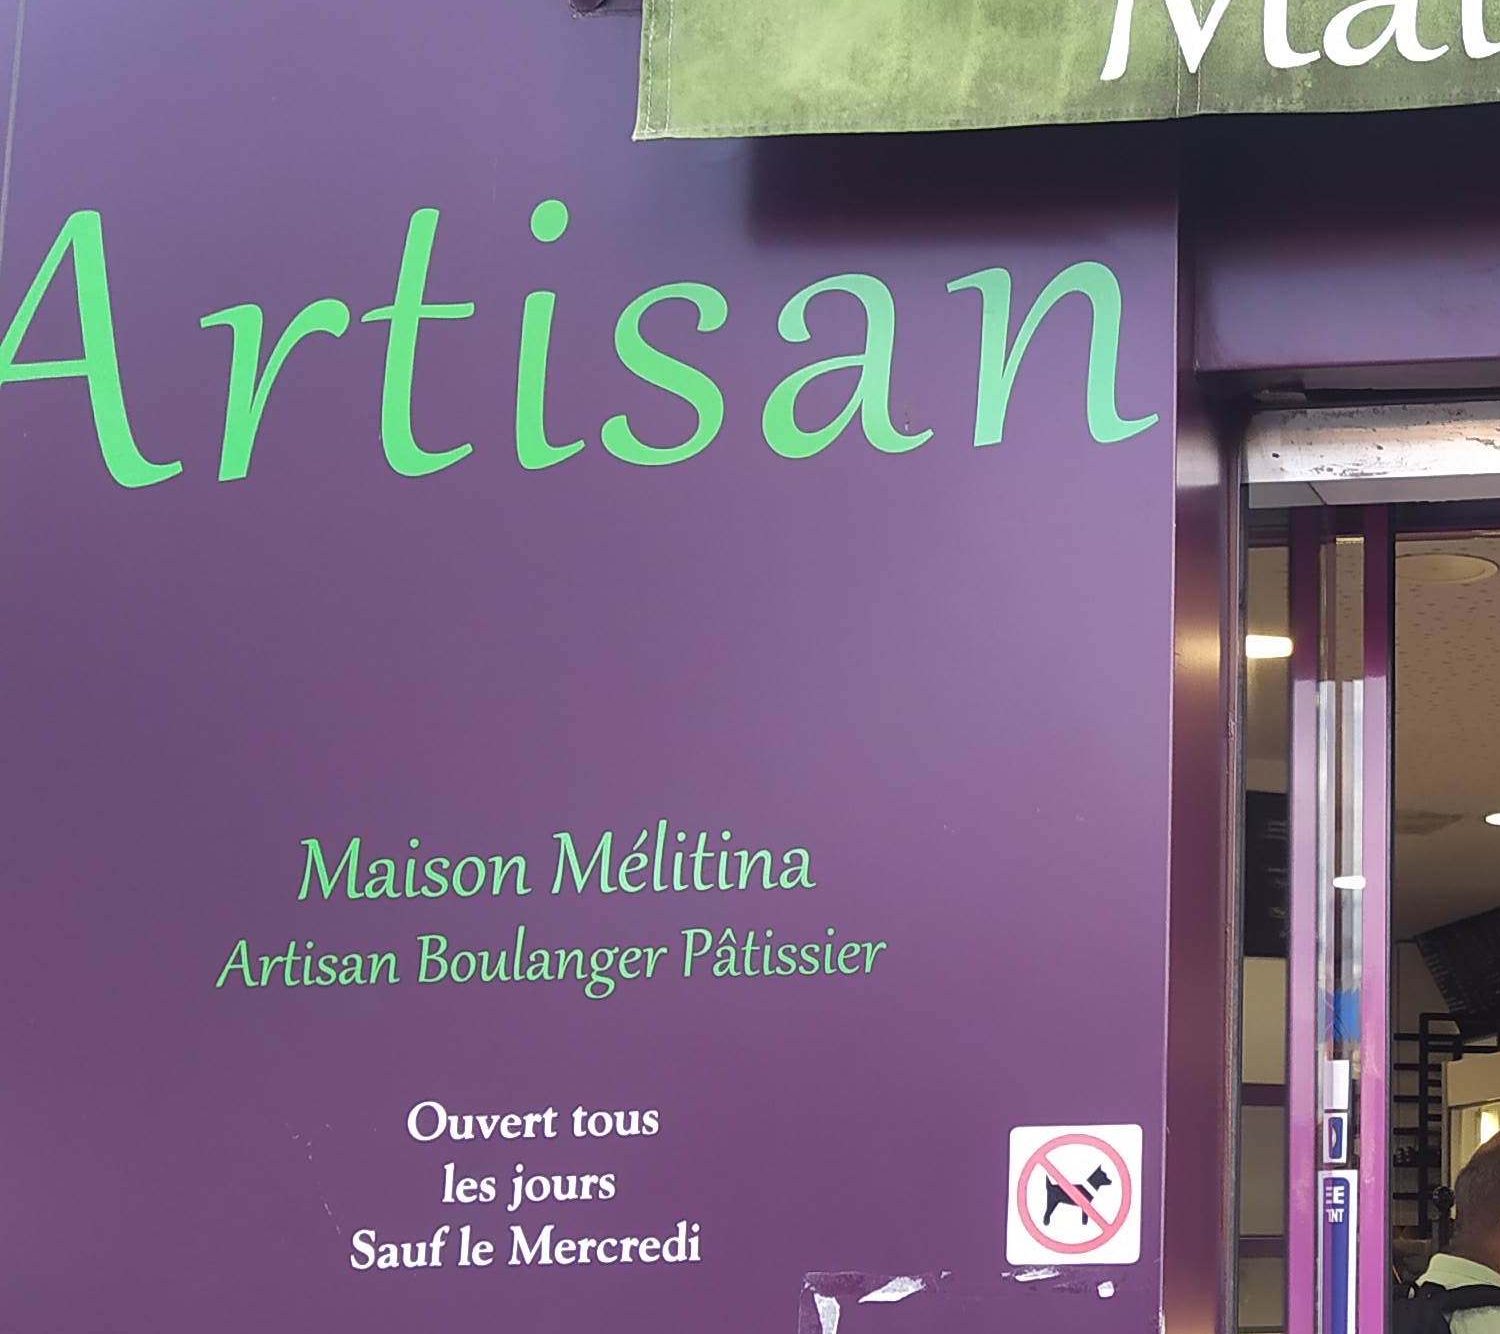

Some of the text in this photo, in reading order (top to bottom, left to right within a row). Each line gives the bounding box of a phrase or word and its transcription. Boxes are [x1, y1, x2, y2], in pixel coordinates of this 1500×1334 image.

[0, 199, 1158, 488] Artisan
[300, 820, 813, 899] Maison Mélitina
[216, 926, 887, 999] Artisan Boulanger Pâtissier
[407, 1101, 660, 1141] Ouvert tous
[442, 1162, 616, 1212] les jours
[350, 1220, 701, 1270] Sauf le Mercredi
